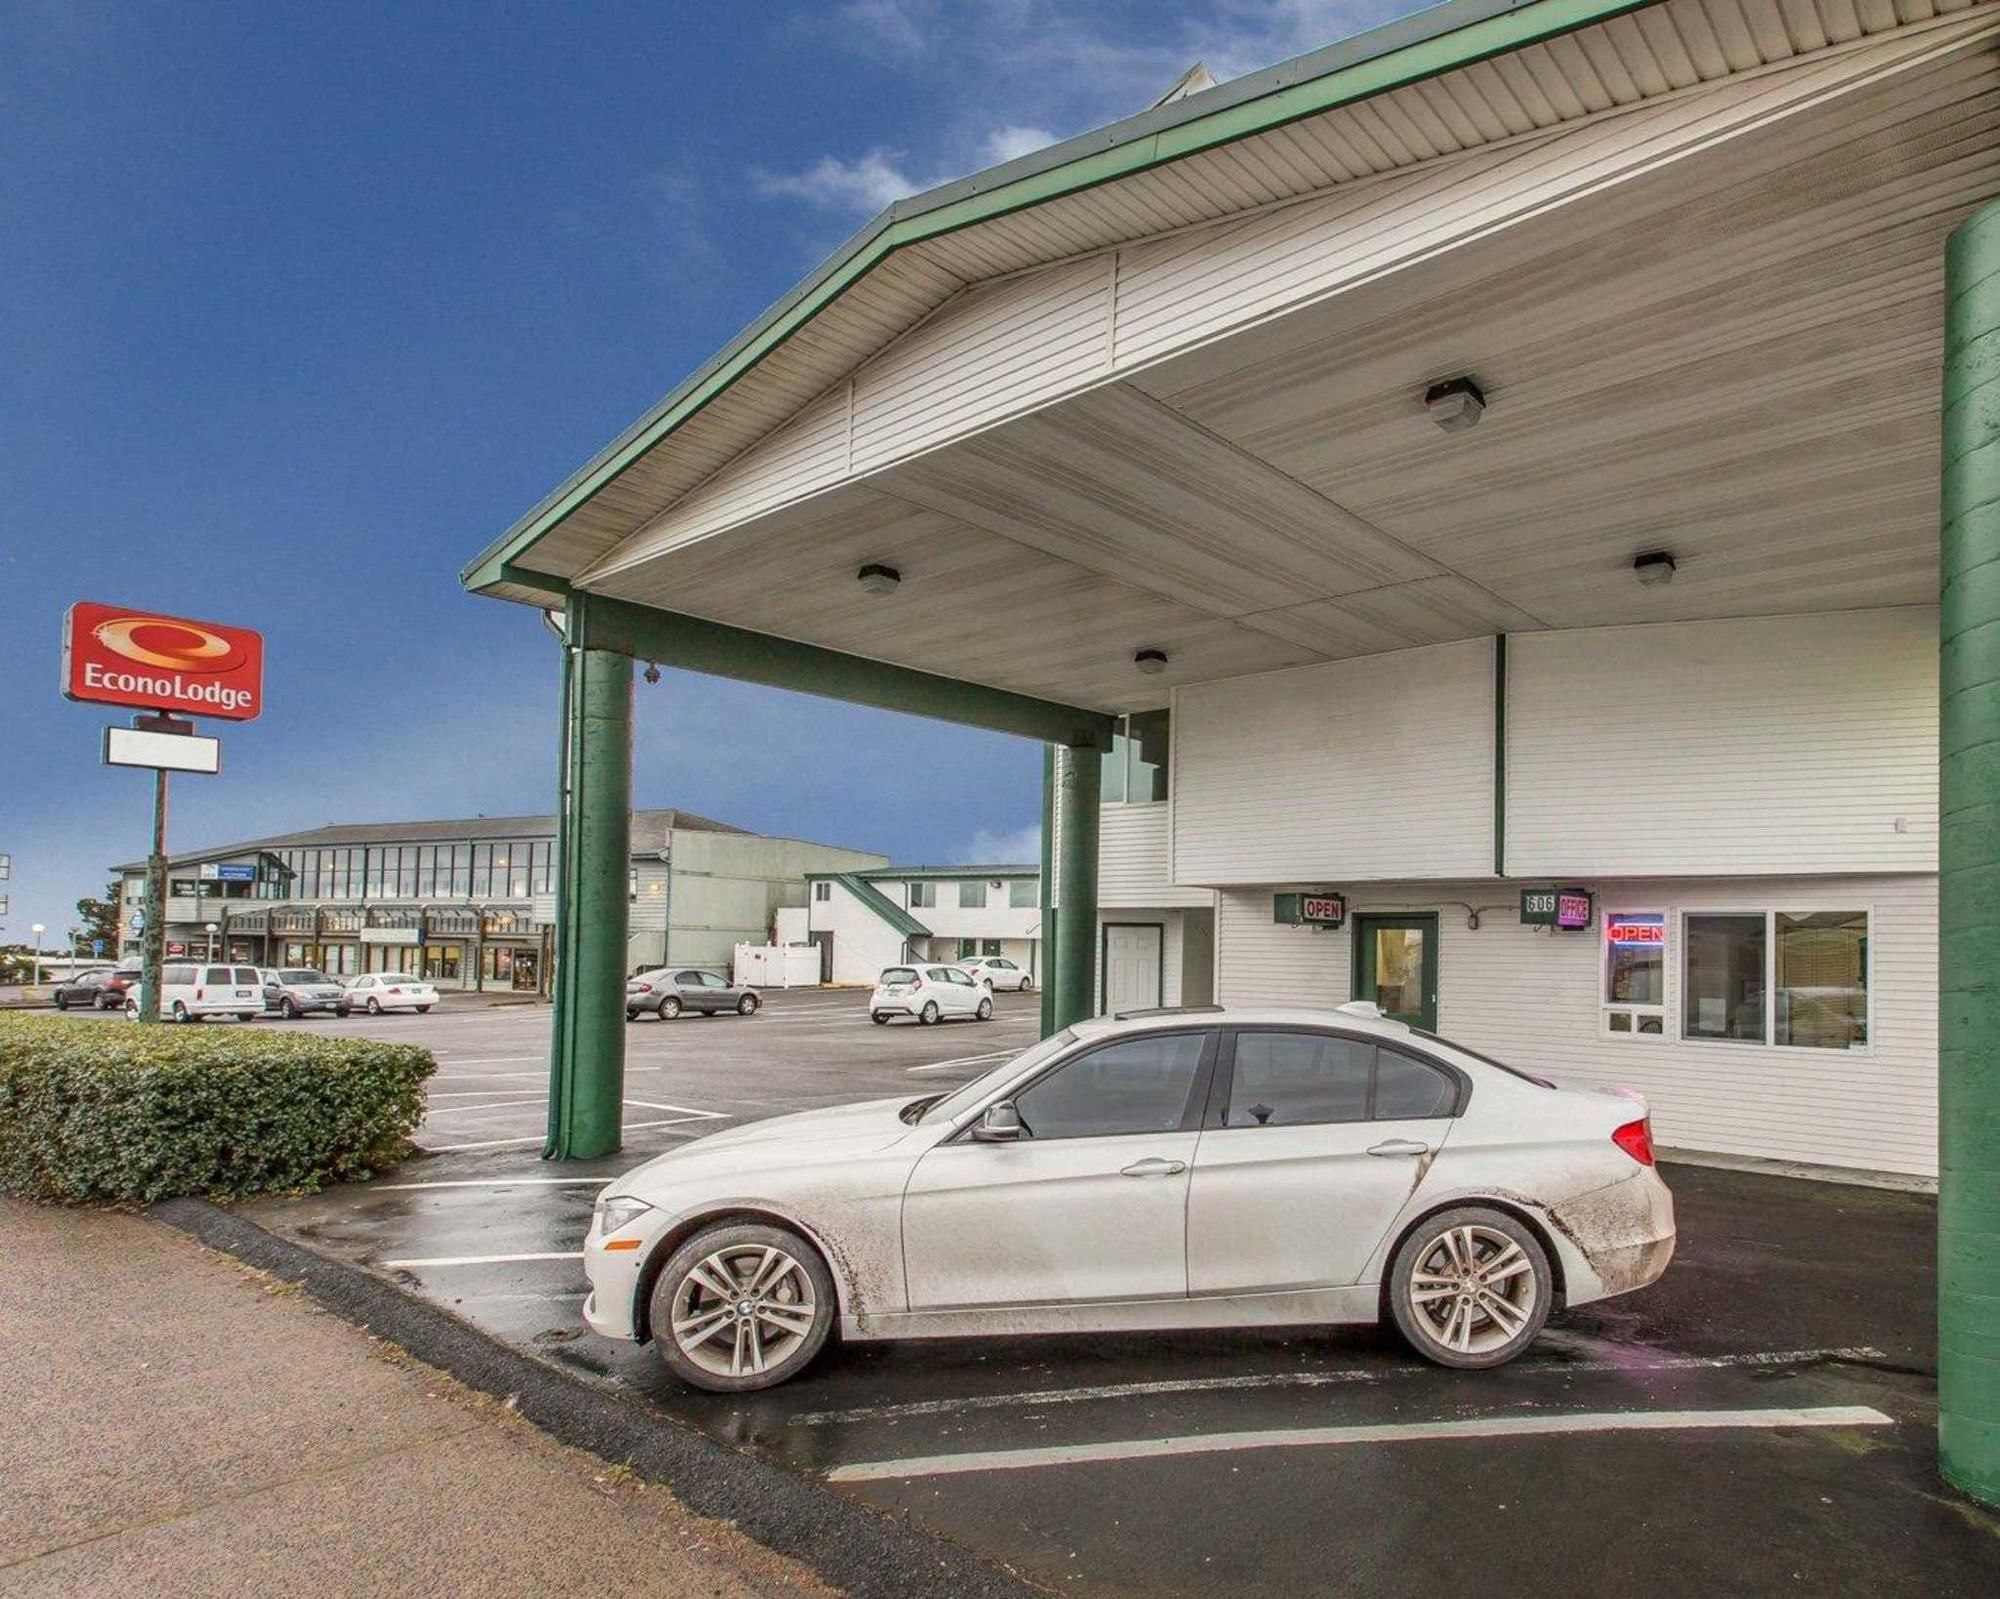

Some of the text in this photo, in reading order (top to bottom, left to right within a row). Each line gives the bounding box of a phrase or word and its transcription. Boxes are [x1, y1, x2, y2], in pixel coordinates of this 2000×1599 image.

[1306, 900, 1340, 919] OPEN
[1561, 898, 1587, 918] OFFICE
[1609, 926, 1665, 941] OPEN
